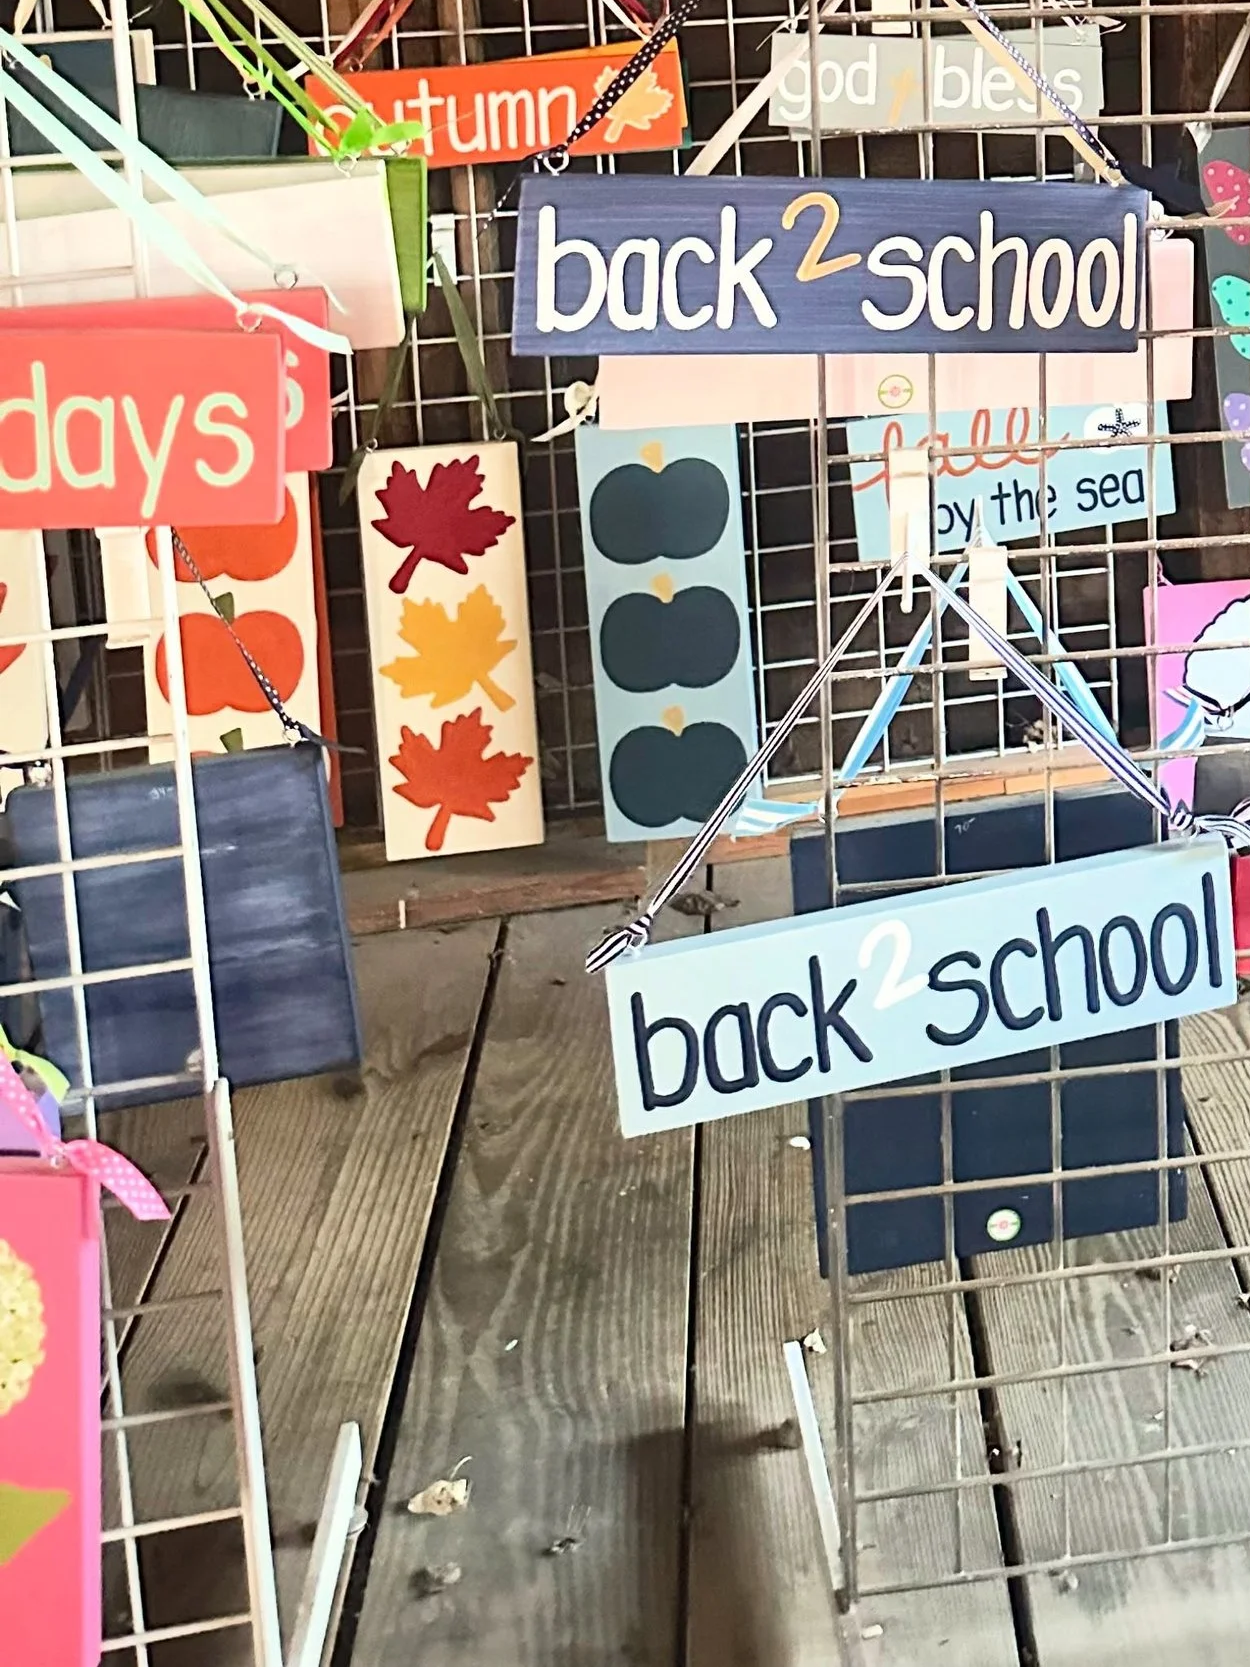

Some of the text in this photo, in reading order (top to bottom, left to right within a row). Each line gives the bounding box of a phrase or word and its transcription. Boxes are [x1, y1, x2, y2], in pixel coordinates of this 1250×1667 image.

[779, 42, 877, 122] god
[536, 191, 1138, 333] back 2 school
[991, 479, 1057, 525] the
[1077, 468, 1145, 513] sea
[631, 871, 1223, 1111] back 2 school
